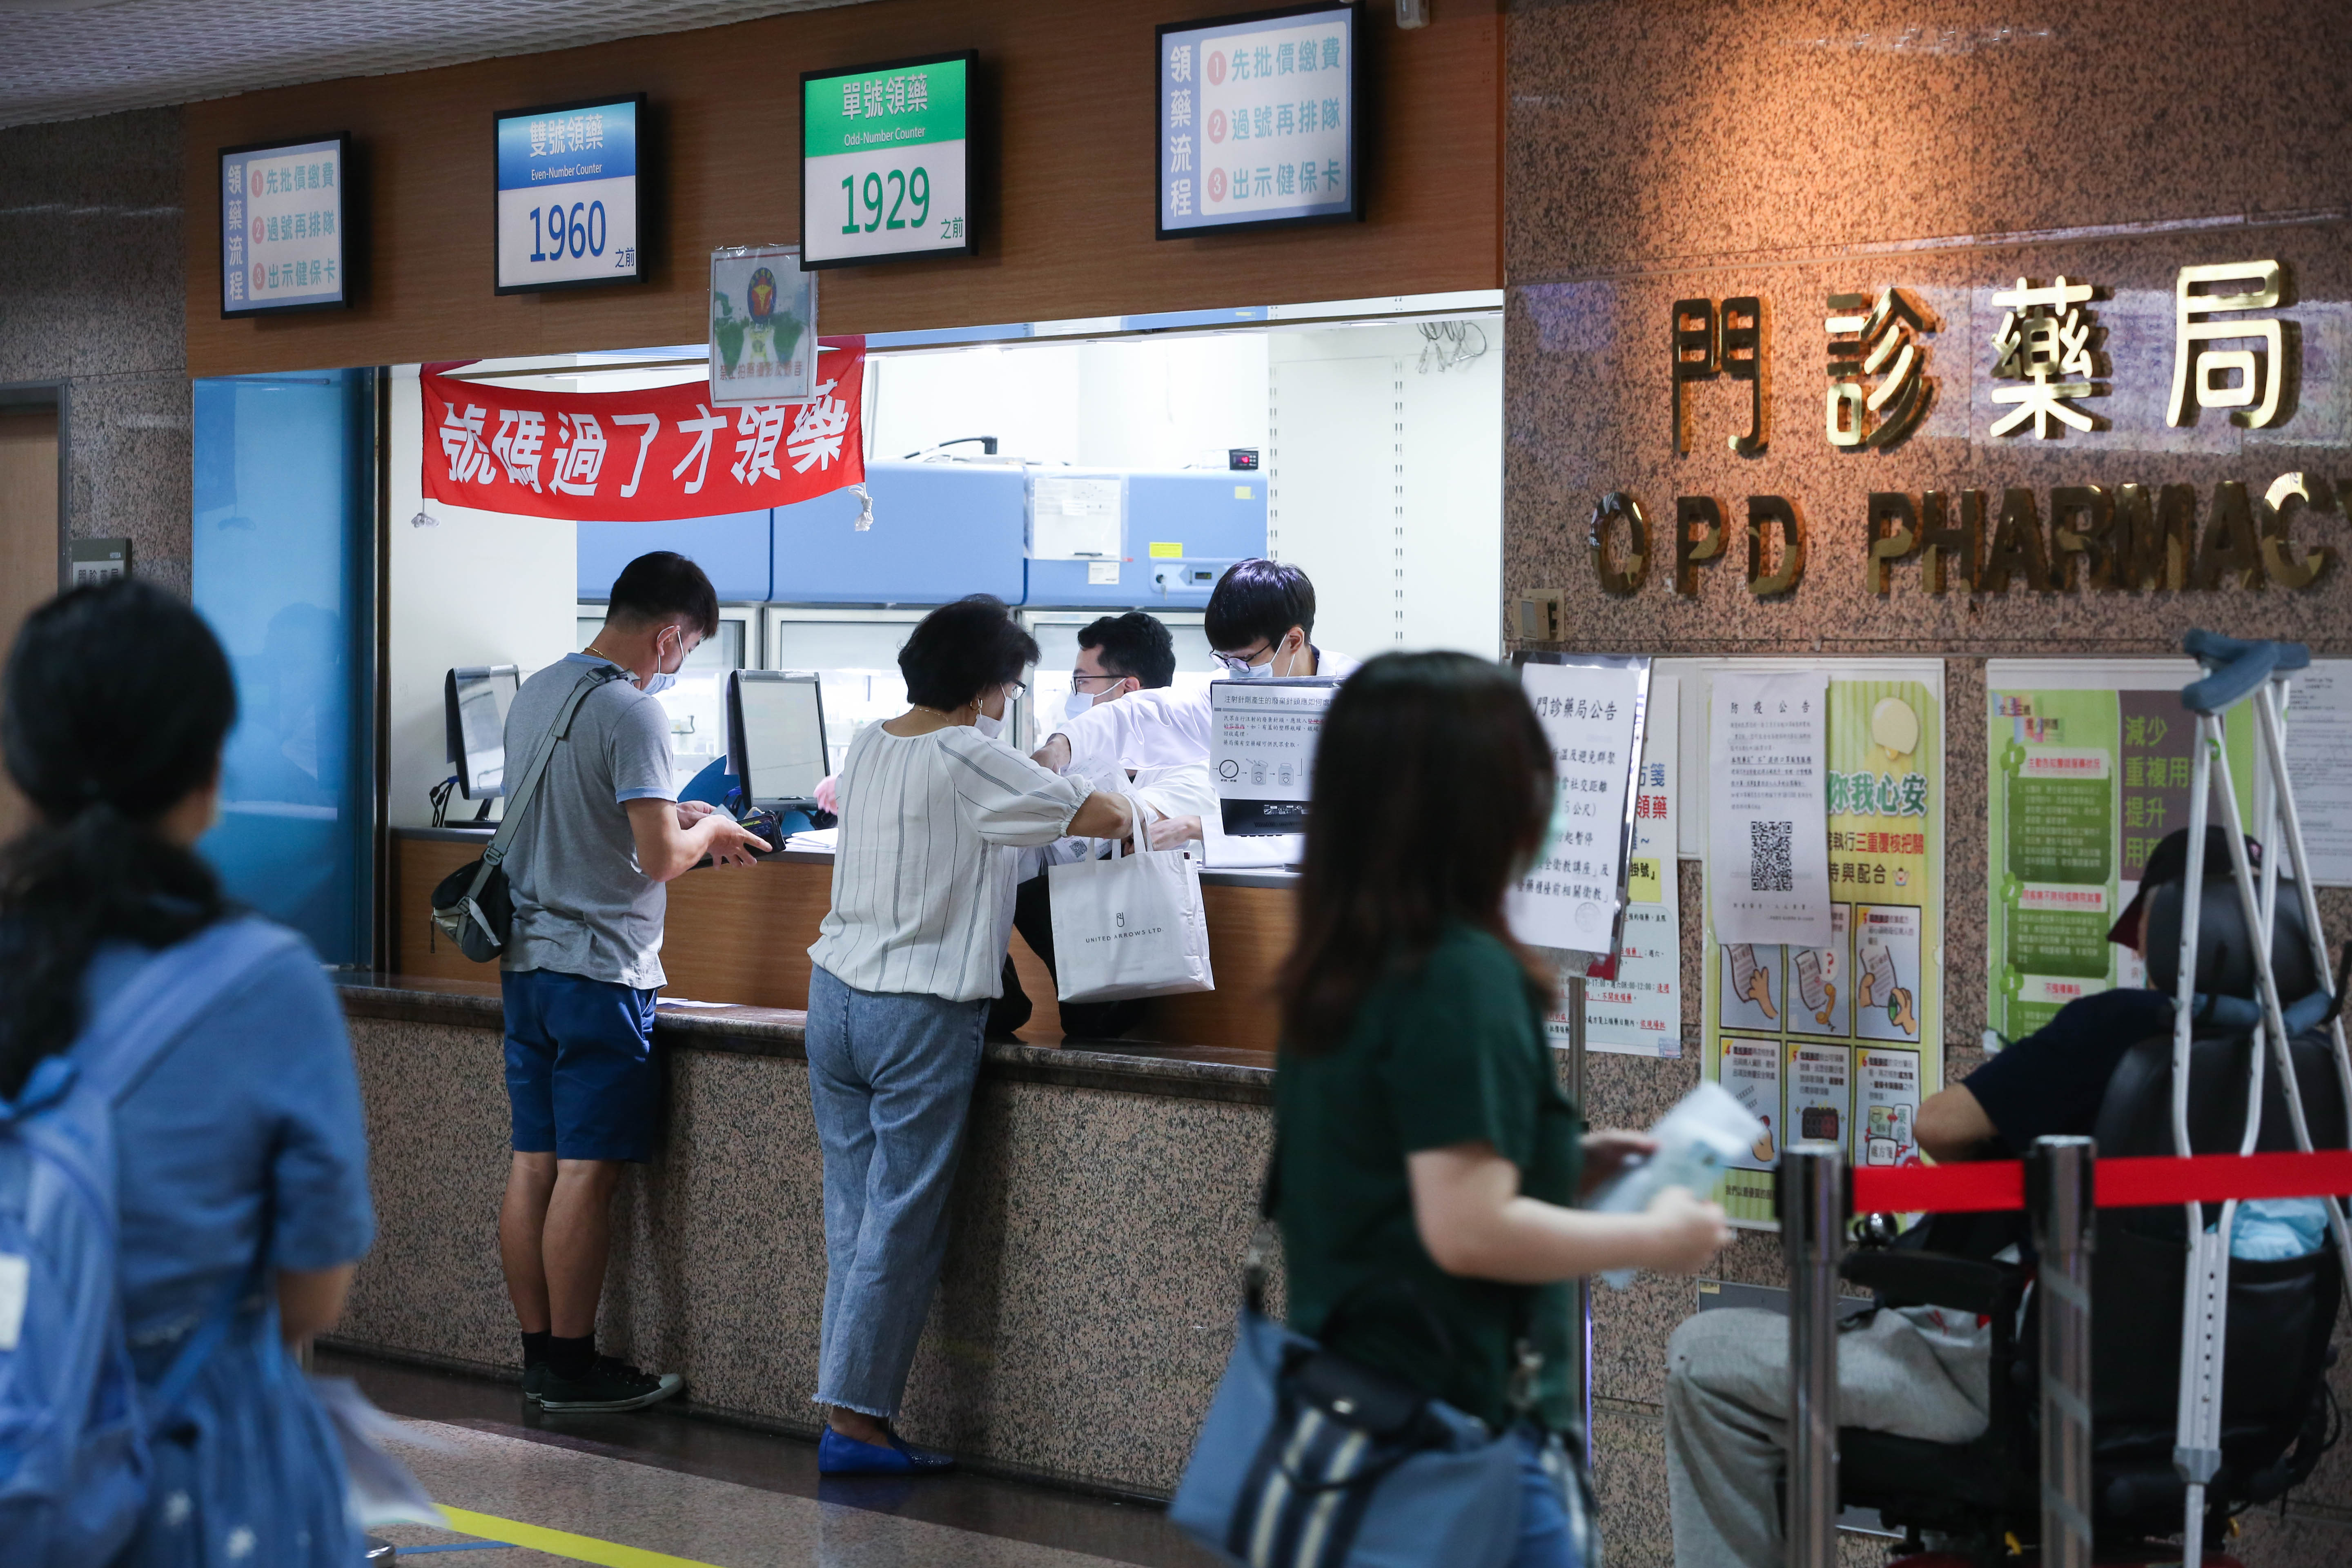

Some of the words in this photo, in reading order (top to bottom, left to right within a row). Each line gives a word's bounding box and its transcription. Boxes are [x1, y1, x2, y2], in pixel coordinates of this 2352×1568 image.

[1214, 58, 1219, 78] 1
[1232, 36, 1341, 82] 先批價繳費
[842, 73, 928, 120] 單號領藥
[1170, 45, 1192, 217] 領藥流程
[1214, 117, 1221, 136] 2
[1232, 97, 1341, 141] 過號再排隊
[530, 114, 604, 158] 雙號領藥
[844, 130, 893, 146] Odd-Number
[895, 127, 925, 140] Counter
[256, 175, 260, 192] 1
[266, 162, 334, 195] 先批價繳費
[531, 165, 575, 182] Even-Number
[576, 163, 602, 176] Counter
[1214, 175, 1221, 194] 3
[1233, 158, 1341, 200] 出示健保卡
[842, 167, 930, 234] 1929
[228, 165, 243, 301] 領藥流程
[255, 221, 261, 238] 2
[266, 210, 335, 243] 過號再排隊
[530, 200, 606, 262] 1960
[940, 217, 963, 239] 之前
[256, 269, 262, 285] 3
[268, 259, 336, 289] 出示健保卡
[615, 247, 635, 268] 之前
[1672, 259, 2283, 453] 門診藥局
[439, 378, 849, 498] 號碼過了才領藥
[1590, 492, 1802, 595] OPD
[1867, 471, 2352, 595] PHARMAC
[1535, 697, 1617, 720] 門診藥局公告
[1731, 699, 1810, 714] 防疫公告
[2125, 715, 2168, 747] 減少
[1637, 795, 1667, 820] 領藥
[2125, 796, 2167, 828] 提升
[1114, 930, 1145, 939] ARROWS
